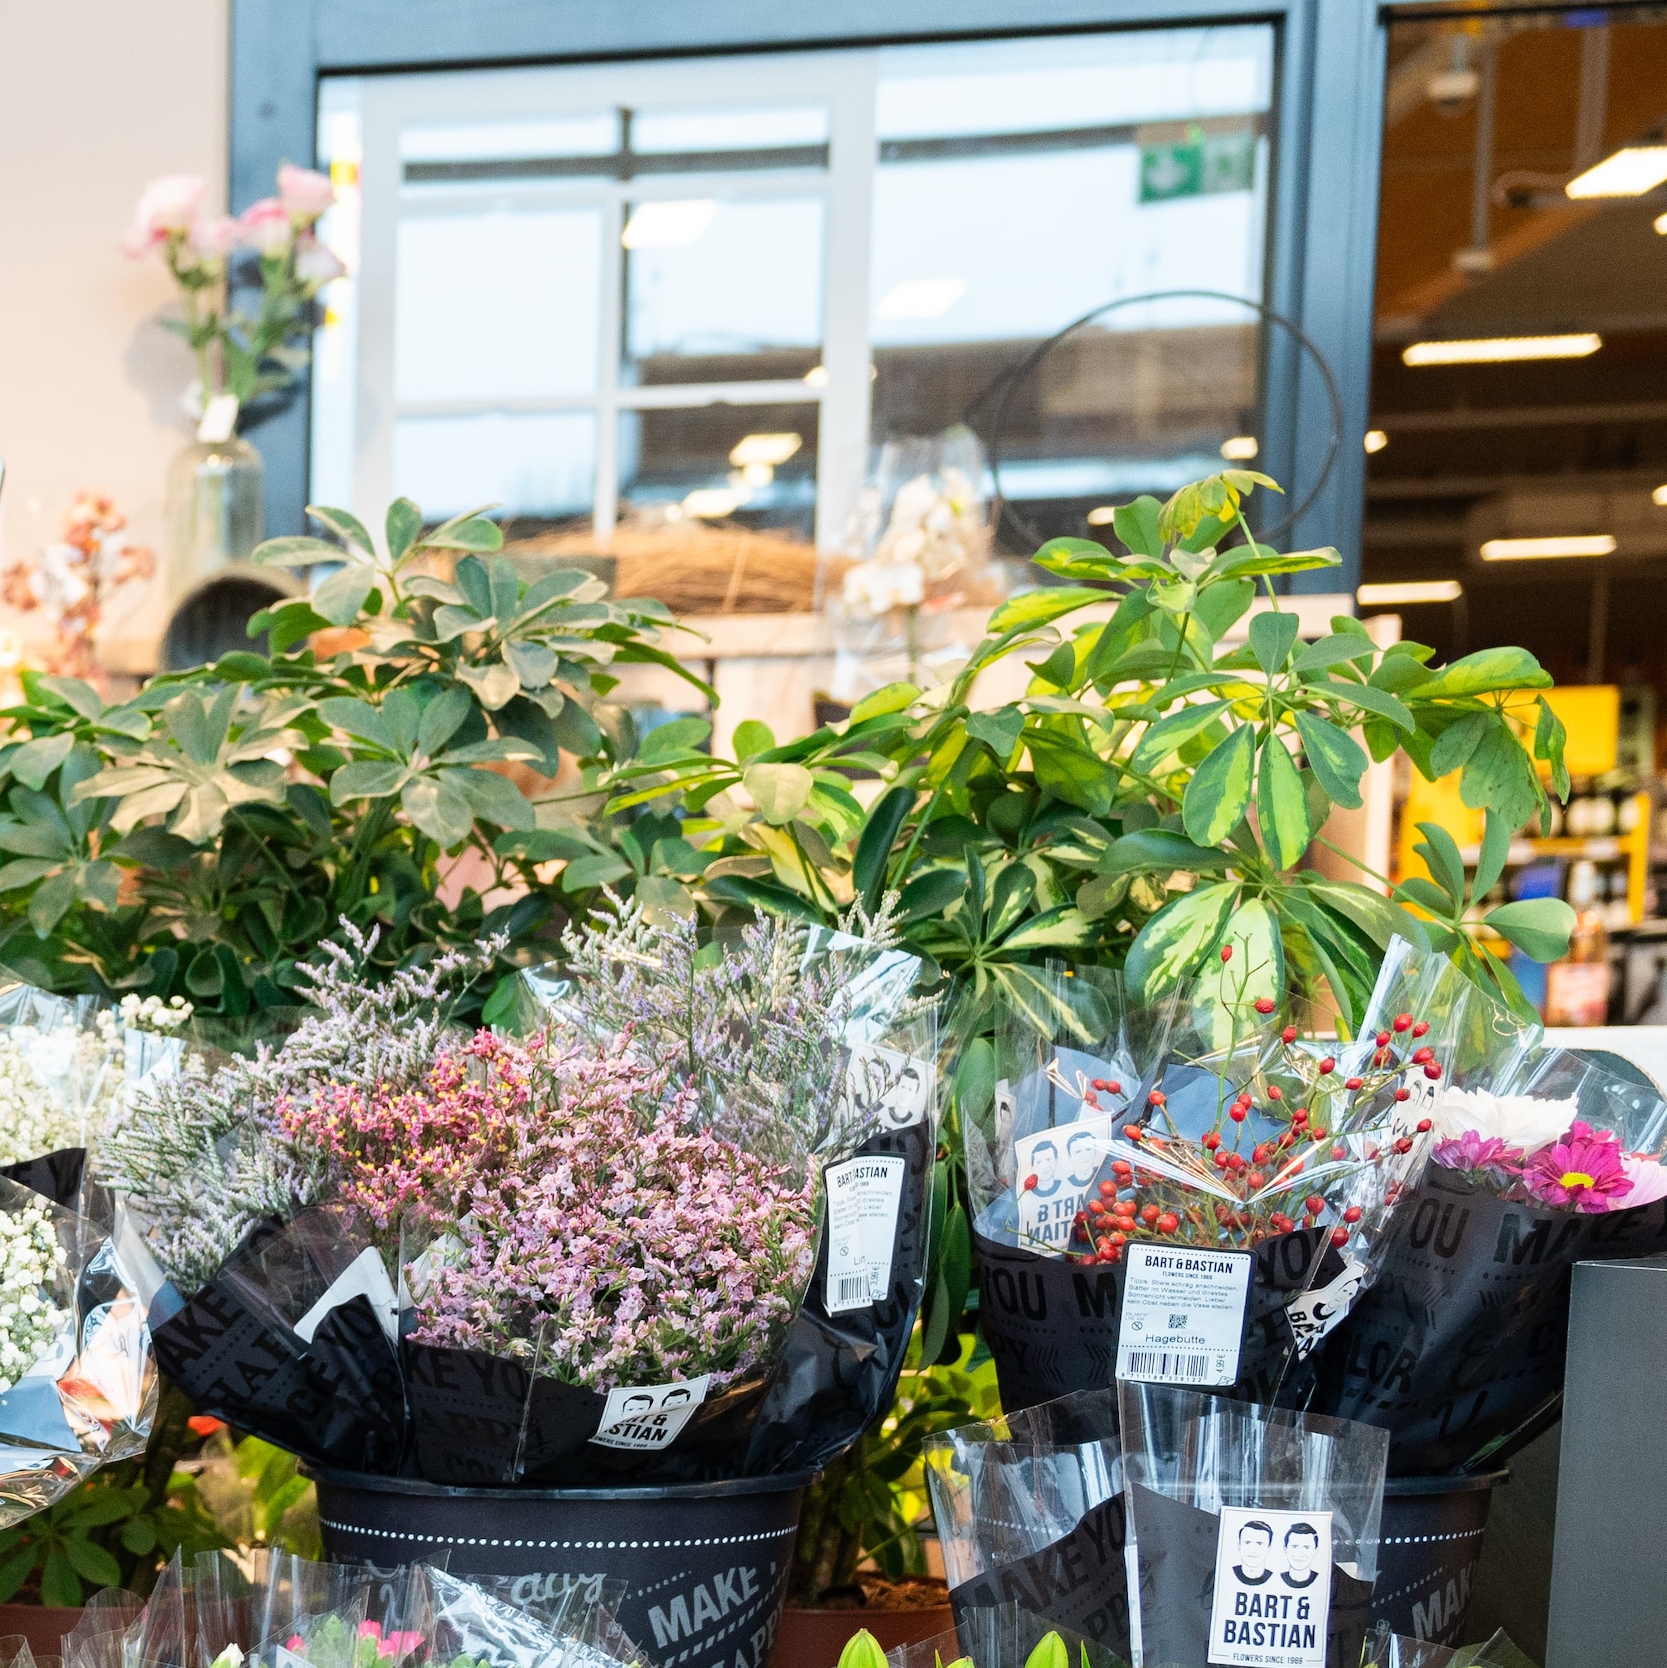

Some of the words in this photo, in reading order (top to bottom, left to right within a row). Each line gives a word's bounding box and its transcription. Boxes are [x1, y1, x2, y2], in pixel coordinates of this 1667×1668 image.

[1145, 1255, 1174, 1267] BART
[1176, 1258, 1183, 1269] &
[1186, 1260, 1233, 1274] BASTIAN
[1128, 1292, 1165, 1300] Sonnenlicht
[1161, 1286, 1187, 1294] Wasser
[1145, 1334, 1206, 1344] Hagebutte
[648, 1564, 760, 1648] MAKE
[1235, 1592, 1293, 1619] BART
[1296, 1596, 1310, 1619] &
[1224, 1620, 1316, 1649] BASTIAN
[1232, 1652, 1264, 1662] FLOWERS
[1266, 1653, 1287, 1663] SINCE
